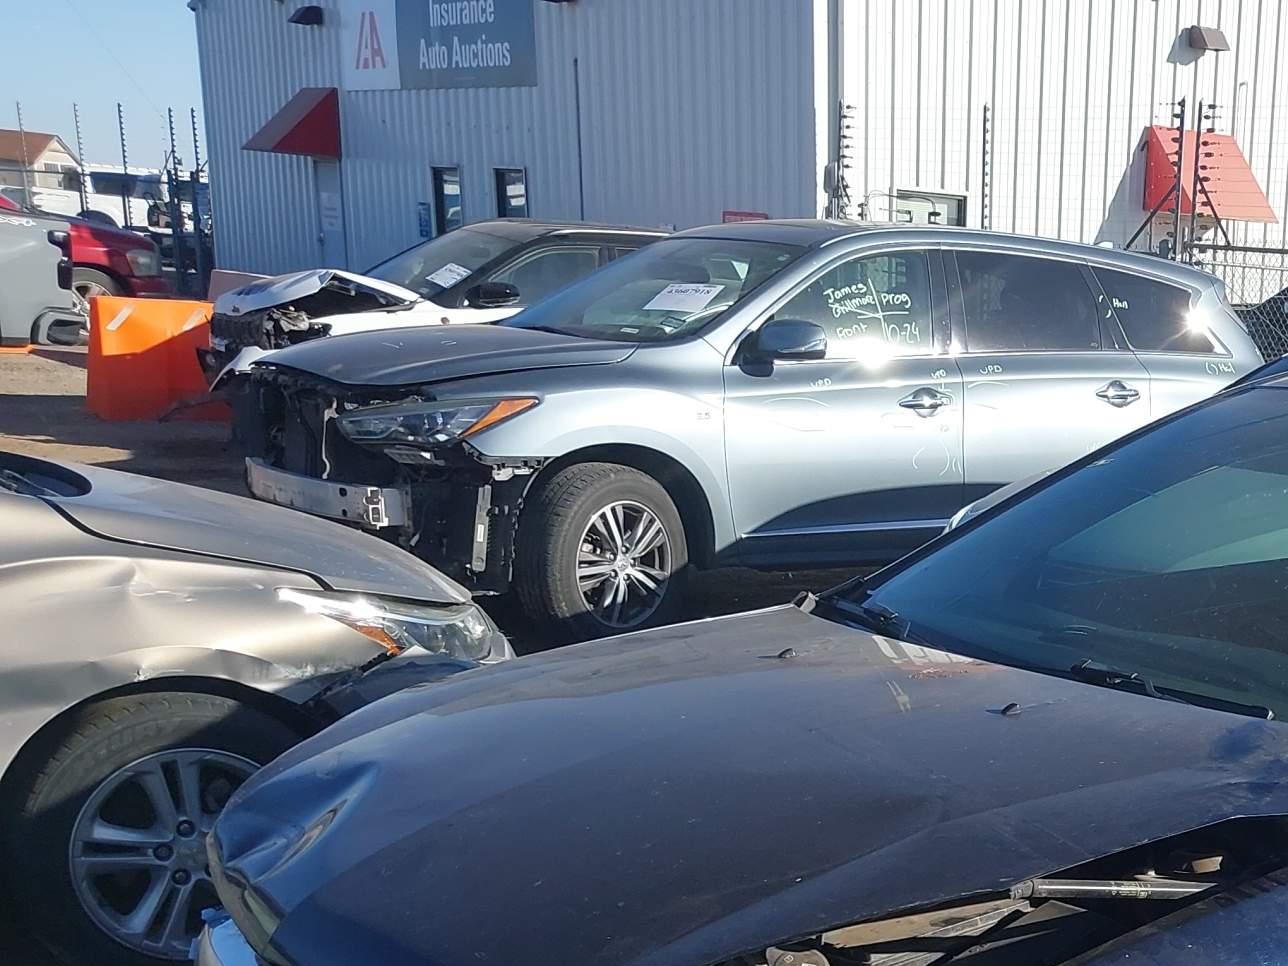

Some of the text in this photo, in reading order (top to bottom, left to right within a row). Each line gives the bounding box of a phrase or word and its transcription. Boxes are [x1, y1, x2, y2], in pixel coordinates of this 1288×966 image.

[429, 0, 495, 27] Insurance
[419, 34, 511, 70] Auto Auctions
[823, 283, 867, 303] James
